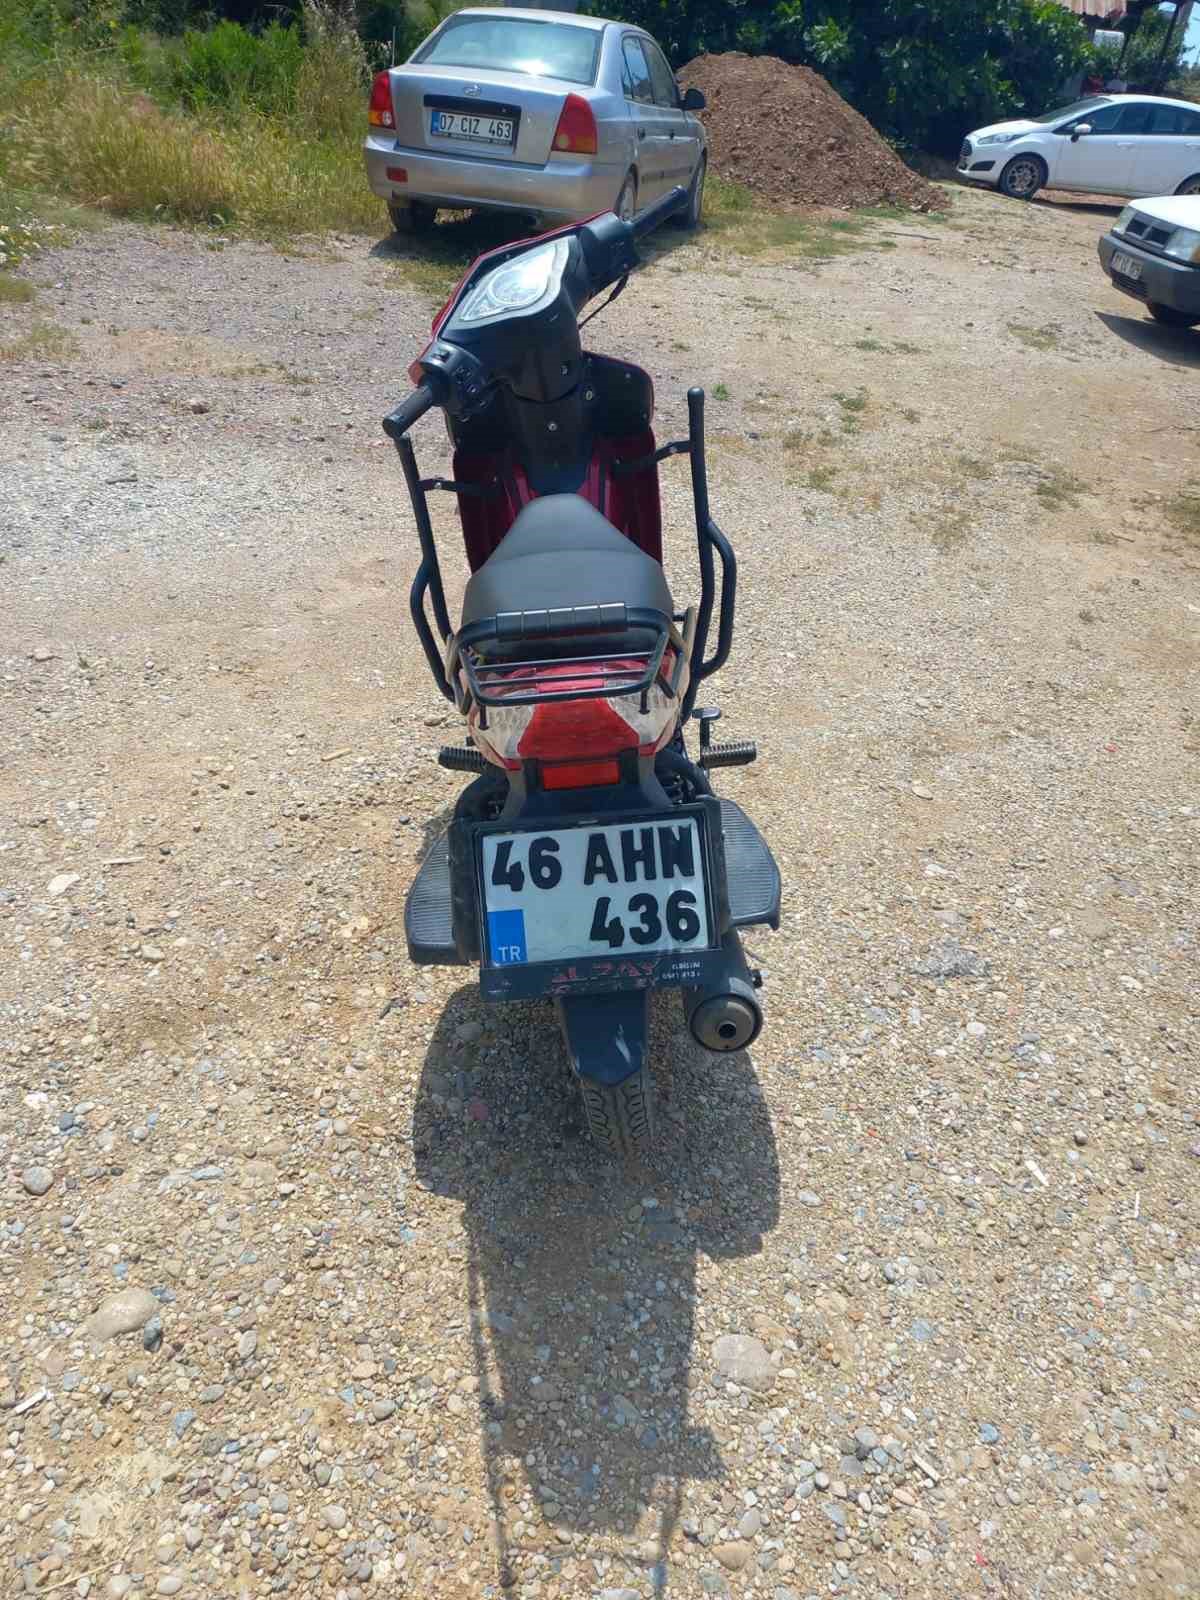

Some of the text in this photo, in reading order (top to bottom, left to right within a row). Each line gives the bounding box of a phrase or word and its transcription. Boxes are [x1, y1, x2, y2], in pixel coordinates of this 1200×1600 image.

[440, 115, 511, 137] 07 CIZ 463
[491, 825, 696, 893] 46 AHN
[589, 889, 701, 948] 436
[497, 945, 521, 962] TR
